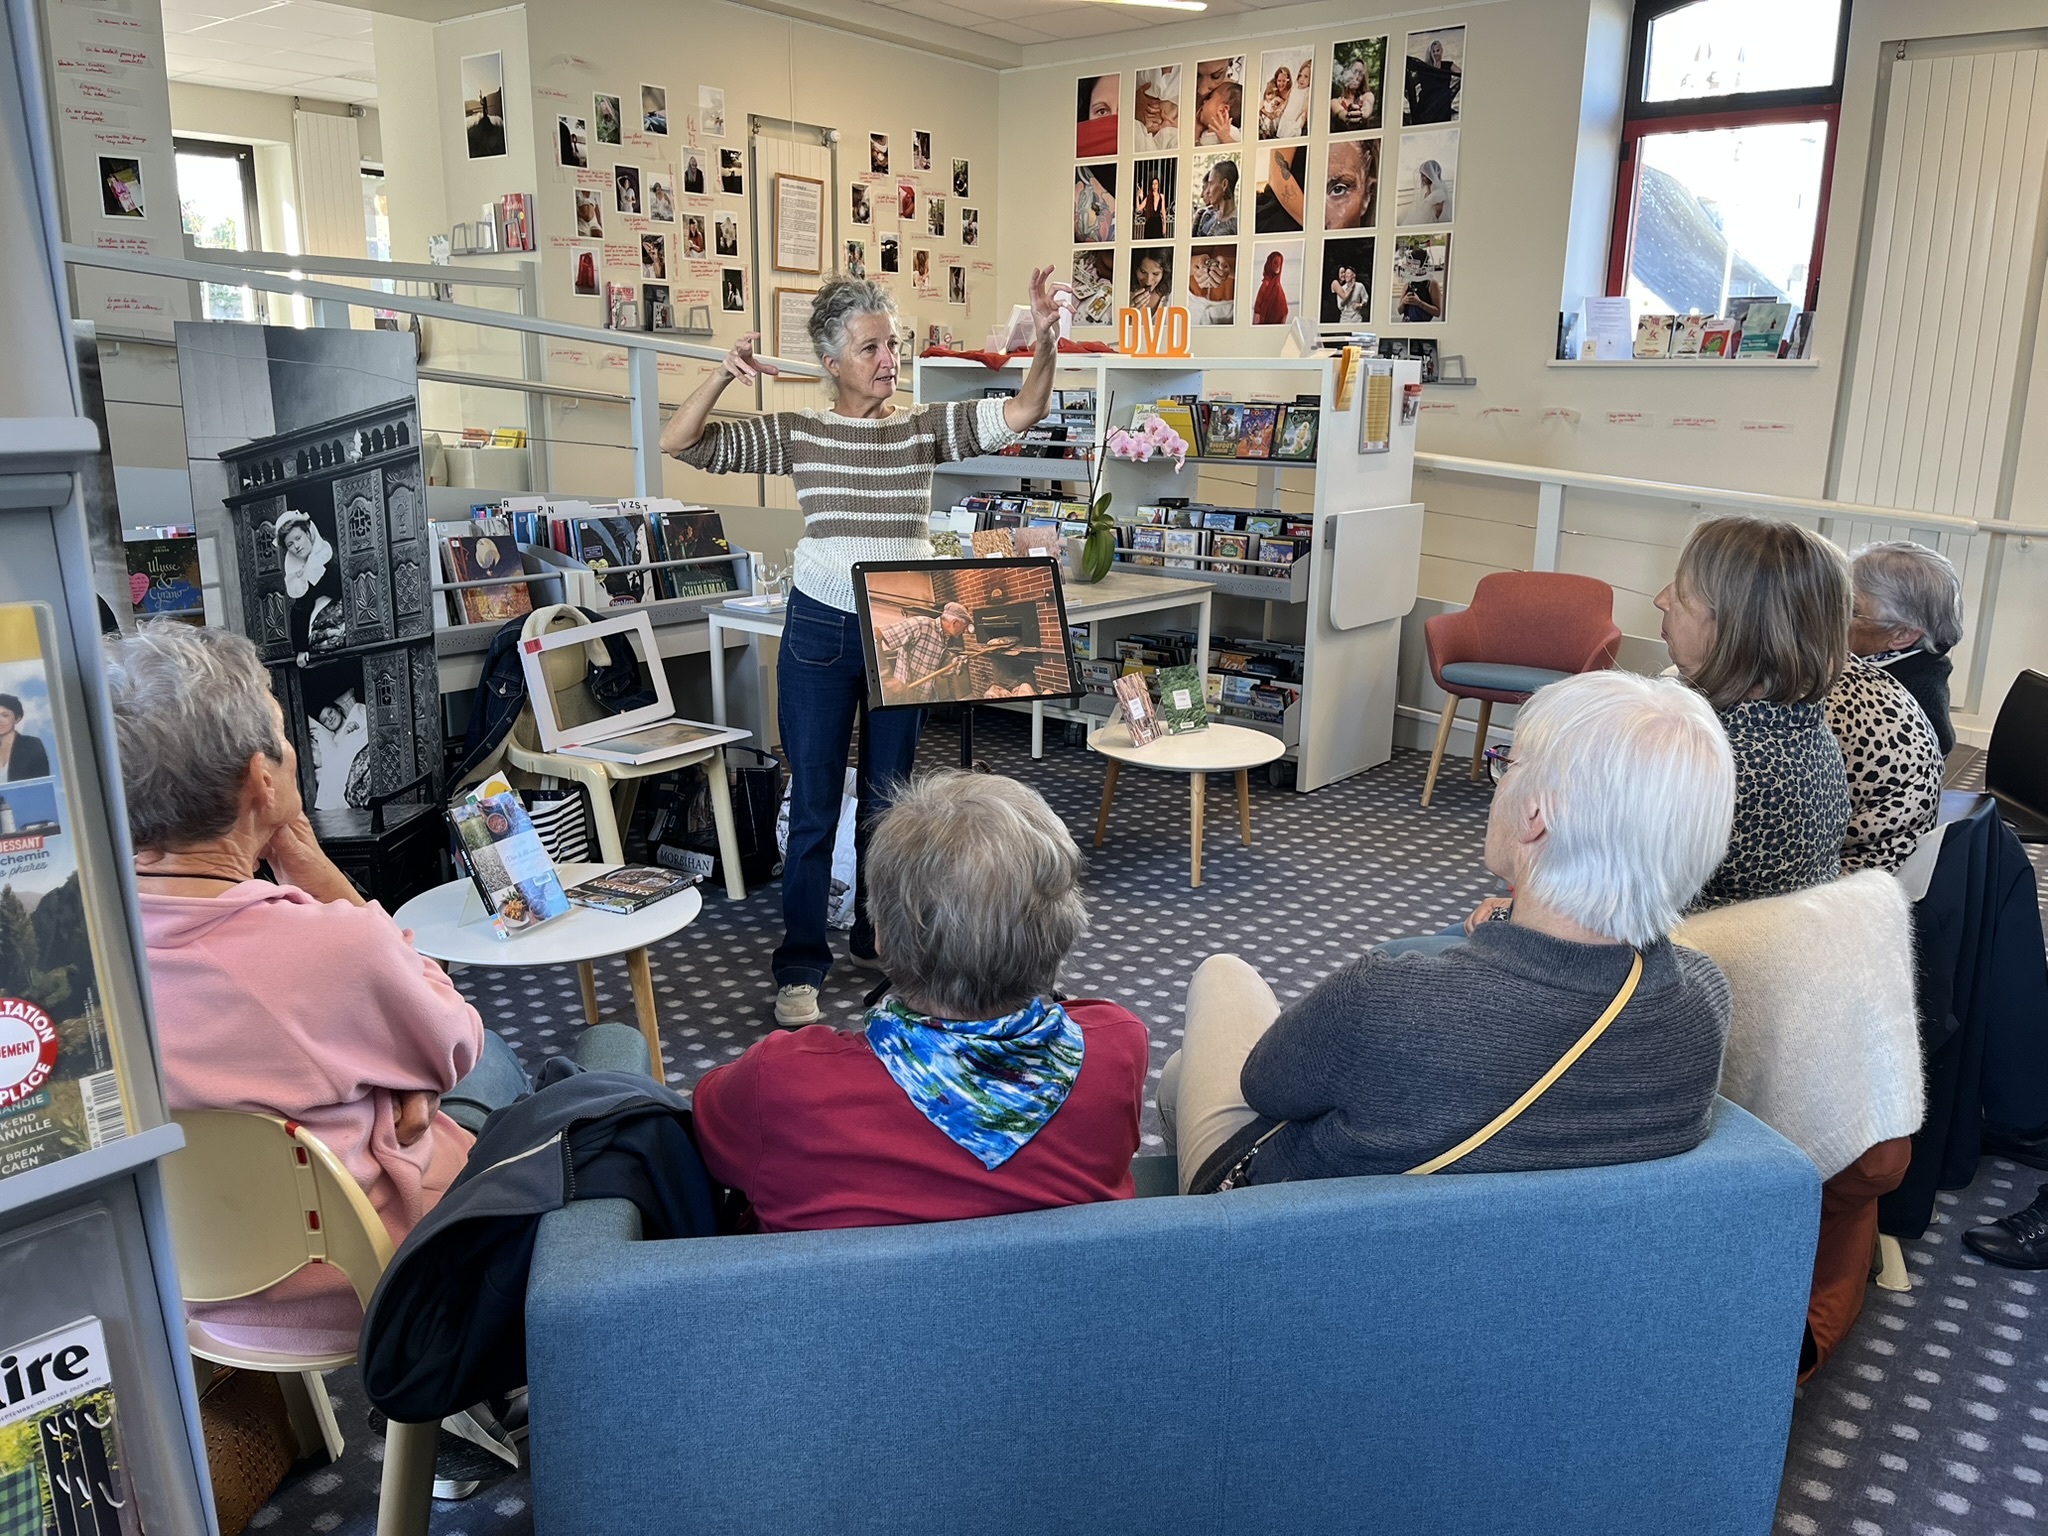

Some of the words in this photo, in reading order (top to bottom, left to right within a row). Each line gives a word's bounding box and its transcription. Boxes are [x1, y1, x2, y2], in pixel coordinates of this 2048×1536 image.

[1119, 306, 1191, 355] DVD
[503, 500, 509, 508] R
[538, 505, 543, 514] P
[548, 506, 554, 514] N
[621, 501, 626, 509] V
[629, 500, 634, 508] Z
[644, 504, 648, 512] T
[147, 556, 181, 574] Ulysse
[149, 586, 190, 607] Cyrano
[682, 581, 728, 598] CHINAMAN
[611, 598, 636, 607] Harlem
[0, 836, 41, 853] ESSANT
[0, 849, 50, 866] chemin
[660, 848, 710, 871] MORBIHAN
[8, 861, 48, 878] phares
[589, 880, 655, 896] SARRASIN
[0, 1000, 55, 1043] TATION
[0, 1040, 35, 1059] EMENT
[0, 1093, 44, 1115] ANDIE
[0, 1113, 36, 1130] K-END
[6, 1143, 45, 1162] BREAK
[1, 1156, 39, 1175] CAEN
[0, 1345, 89, 1407] ire
